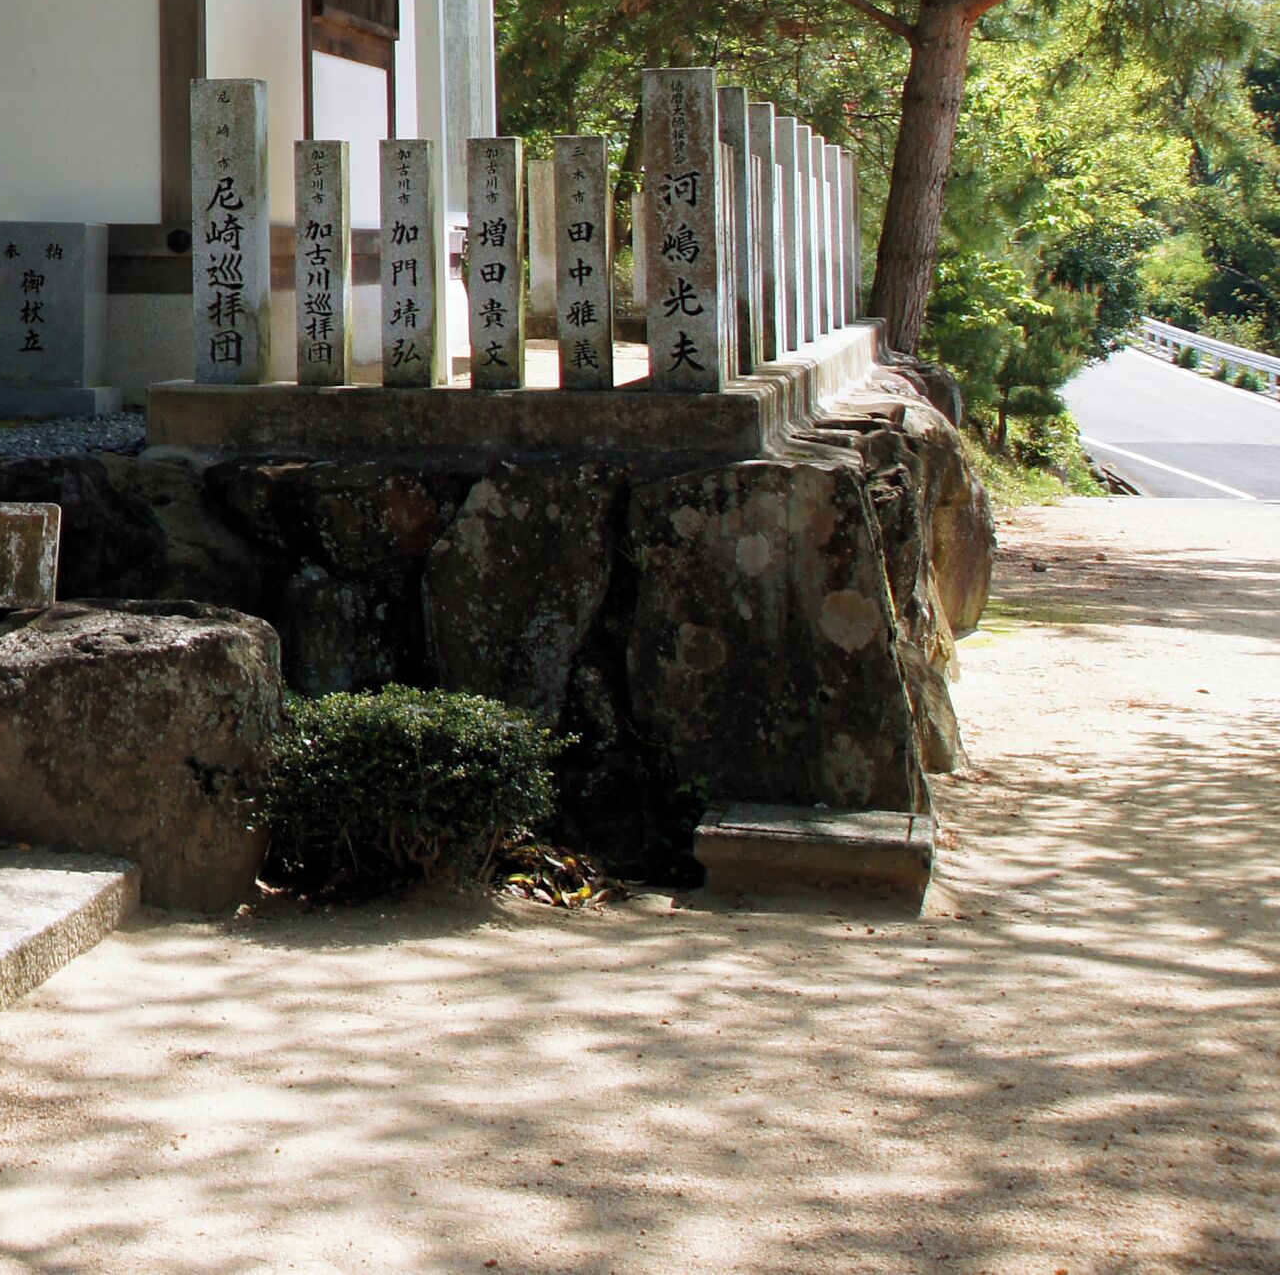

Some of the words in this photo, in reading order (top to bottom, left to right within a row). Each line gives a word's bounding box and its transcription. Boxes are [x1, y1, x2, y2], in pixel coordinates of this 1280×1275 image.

[216, 90, 230, 172] 尼崎市
[311, 149, 325, 206] 加古川市
[397, 148, 411, 206] 加古川市
[485, 147, 499, 206] 加古川市
[571, 145, 586, 205] 三木市
[19, 269, 46, 354] 御杖立
[205, 176, 245, 367] 尼崎巡拝団
[305, 220, 334, 366] 加古川巡拝団
[390, 220, 421, 368] 加門靖弘
[478, 220, 509, 368] 増田貴文
[566, 221, 599, 371] 田中雅義
[660, 170, 706, 373] 河嶋光夫
